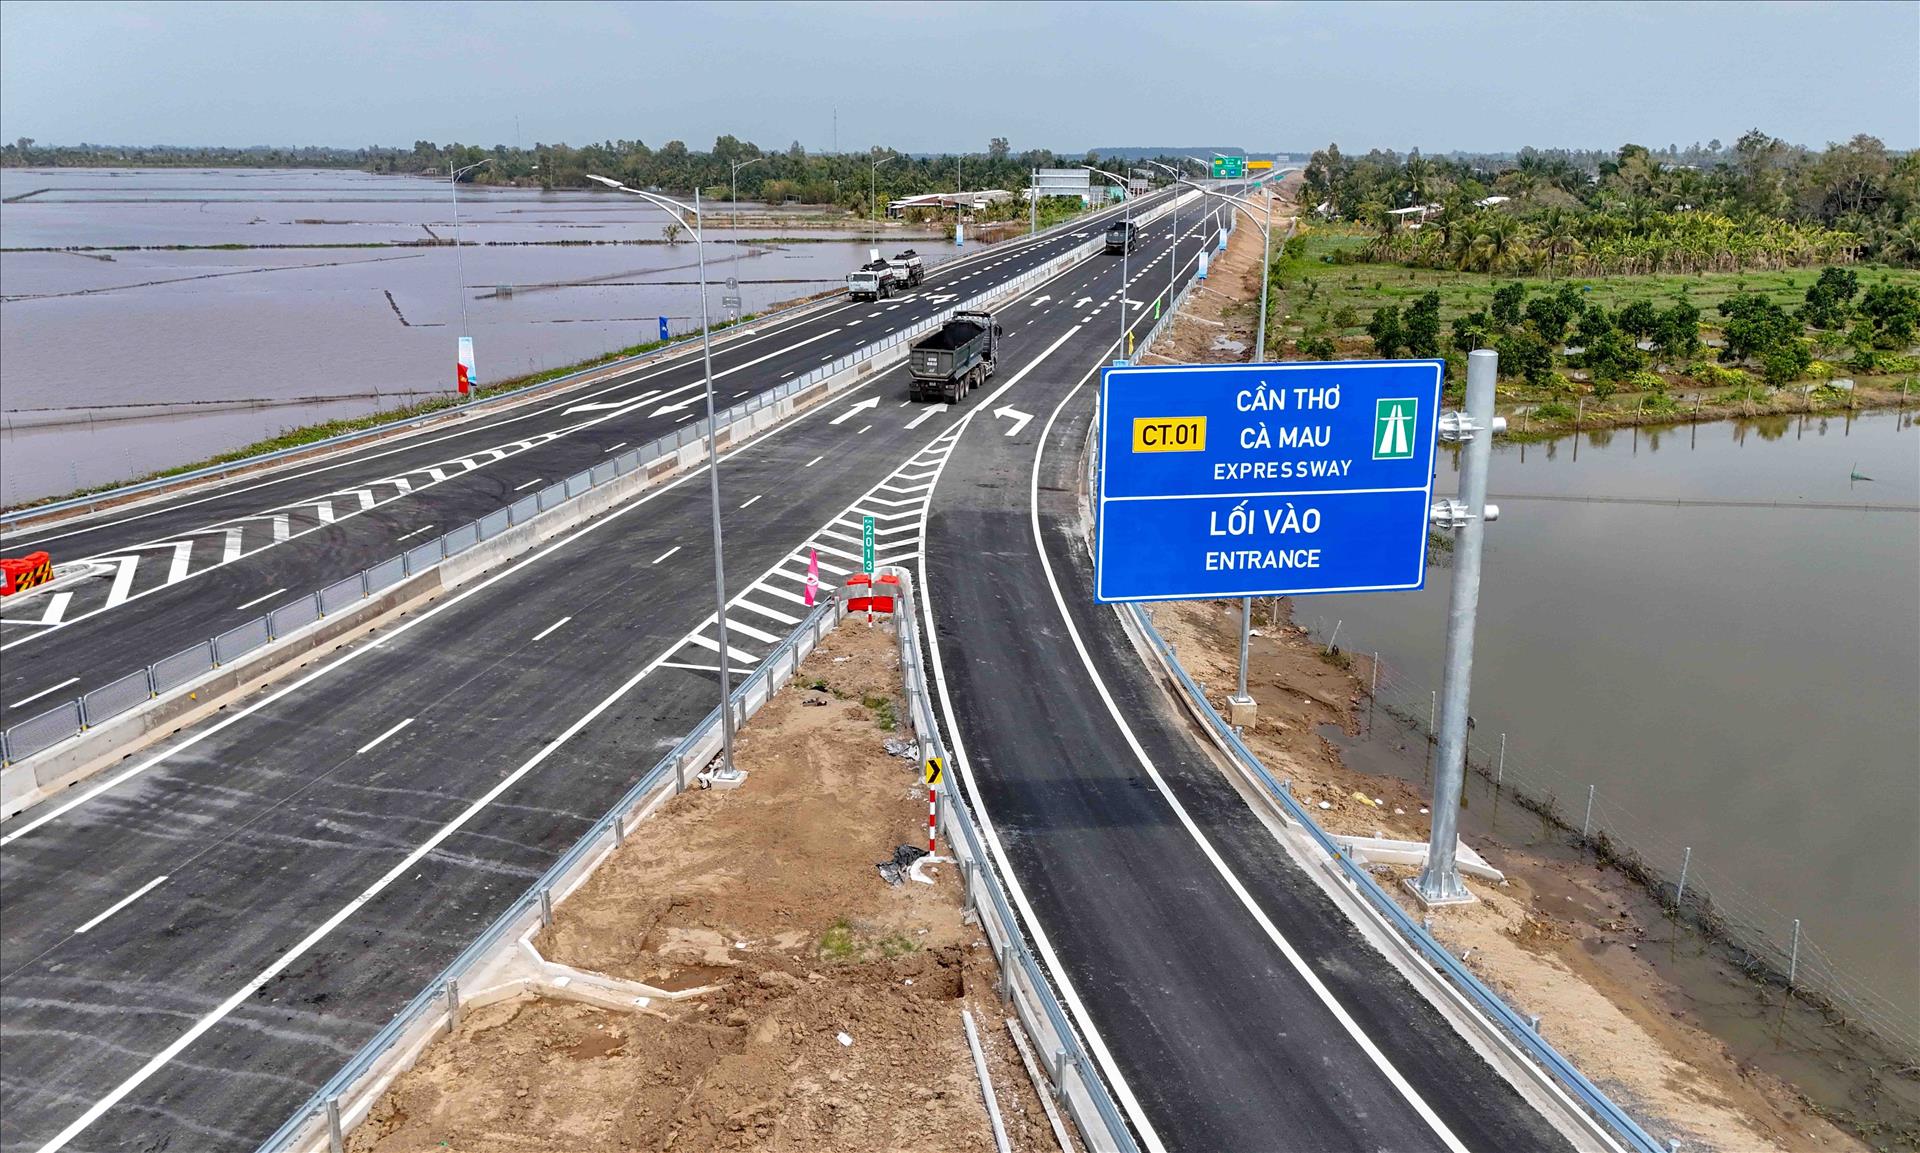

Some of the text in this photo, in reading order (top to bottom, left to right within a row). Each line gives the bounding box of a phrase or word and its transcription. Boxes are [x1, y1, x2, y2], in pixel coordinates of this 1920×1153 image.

[1236, 380, 1340, 412] CẦN THƠ
[1142, 424, 1198, 446] CT.01
[1240, 422, 1331, 449] CÀ MAU
[1214, 460, 1352, 480] EXPRESSWAY
[1210, 500, 1321, 536] LỐI VÀO
[1206, 549, 1321, 570] ENTRANCE
